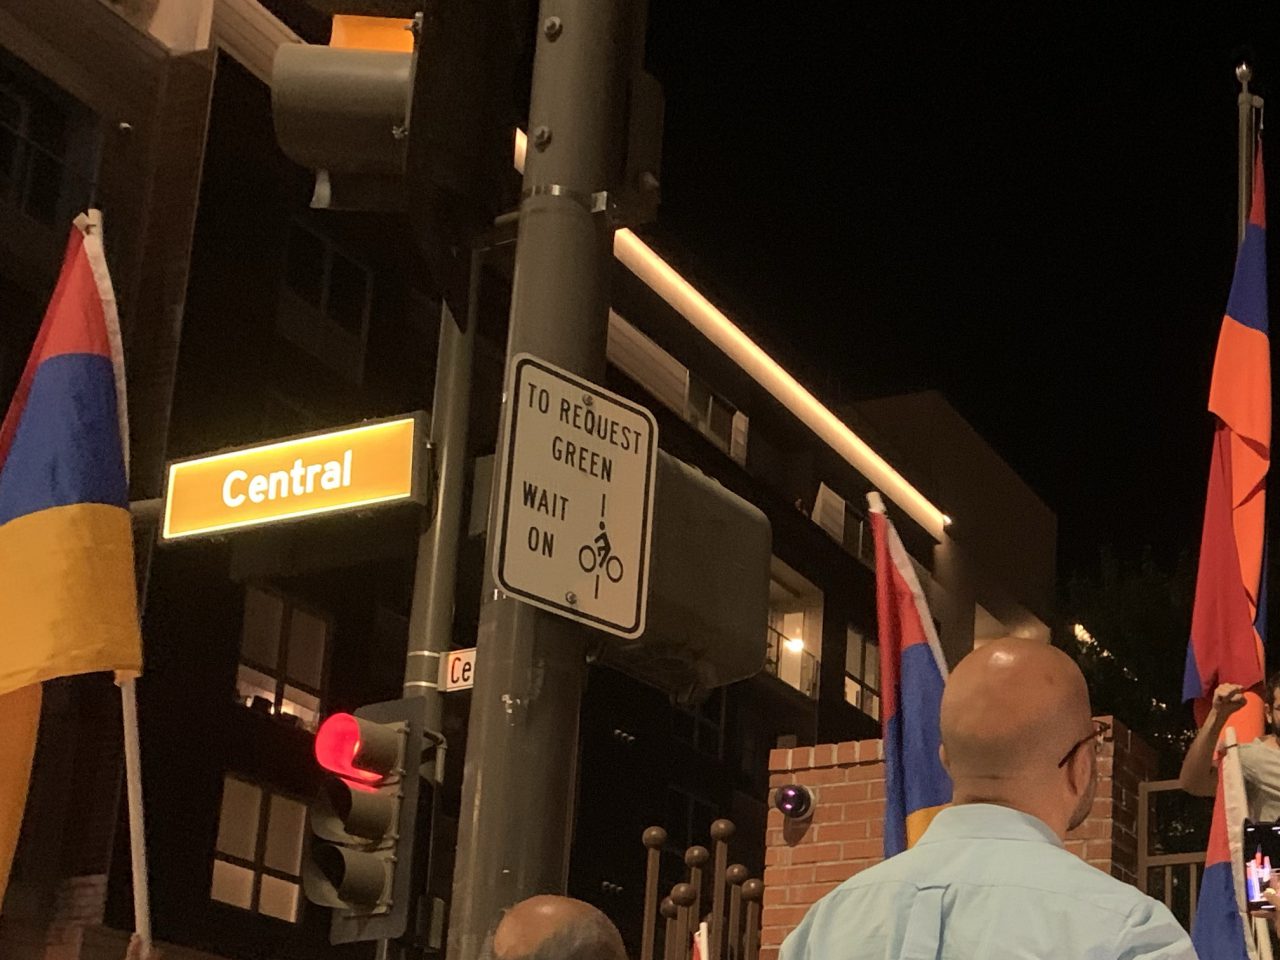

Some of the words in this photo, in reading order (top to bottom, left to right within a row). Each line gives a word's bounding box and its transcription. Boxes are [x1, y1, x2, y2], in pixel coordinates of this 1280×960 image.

[527, 382, 550, 415] TO
[559, 398, 642, 455] REQUEST
[222, 450, 352, 508] Central
[552, 435, 613, 483] GREEN
[523, 480, 569, 521] WAIT
[527, 526, 554, 558] ON
